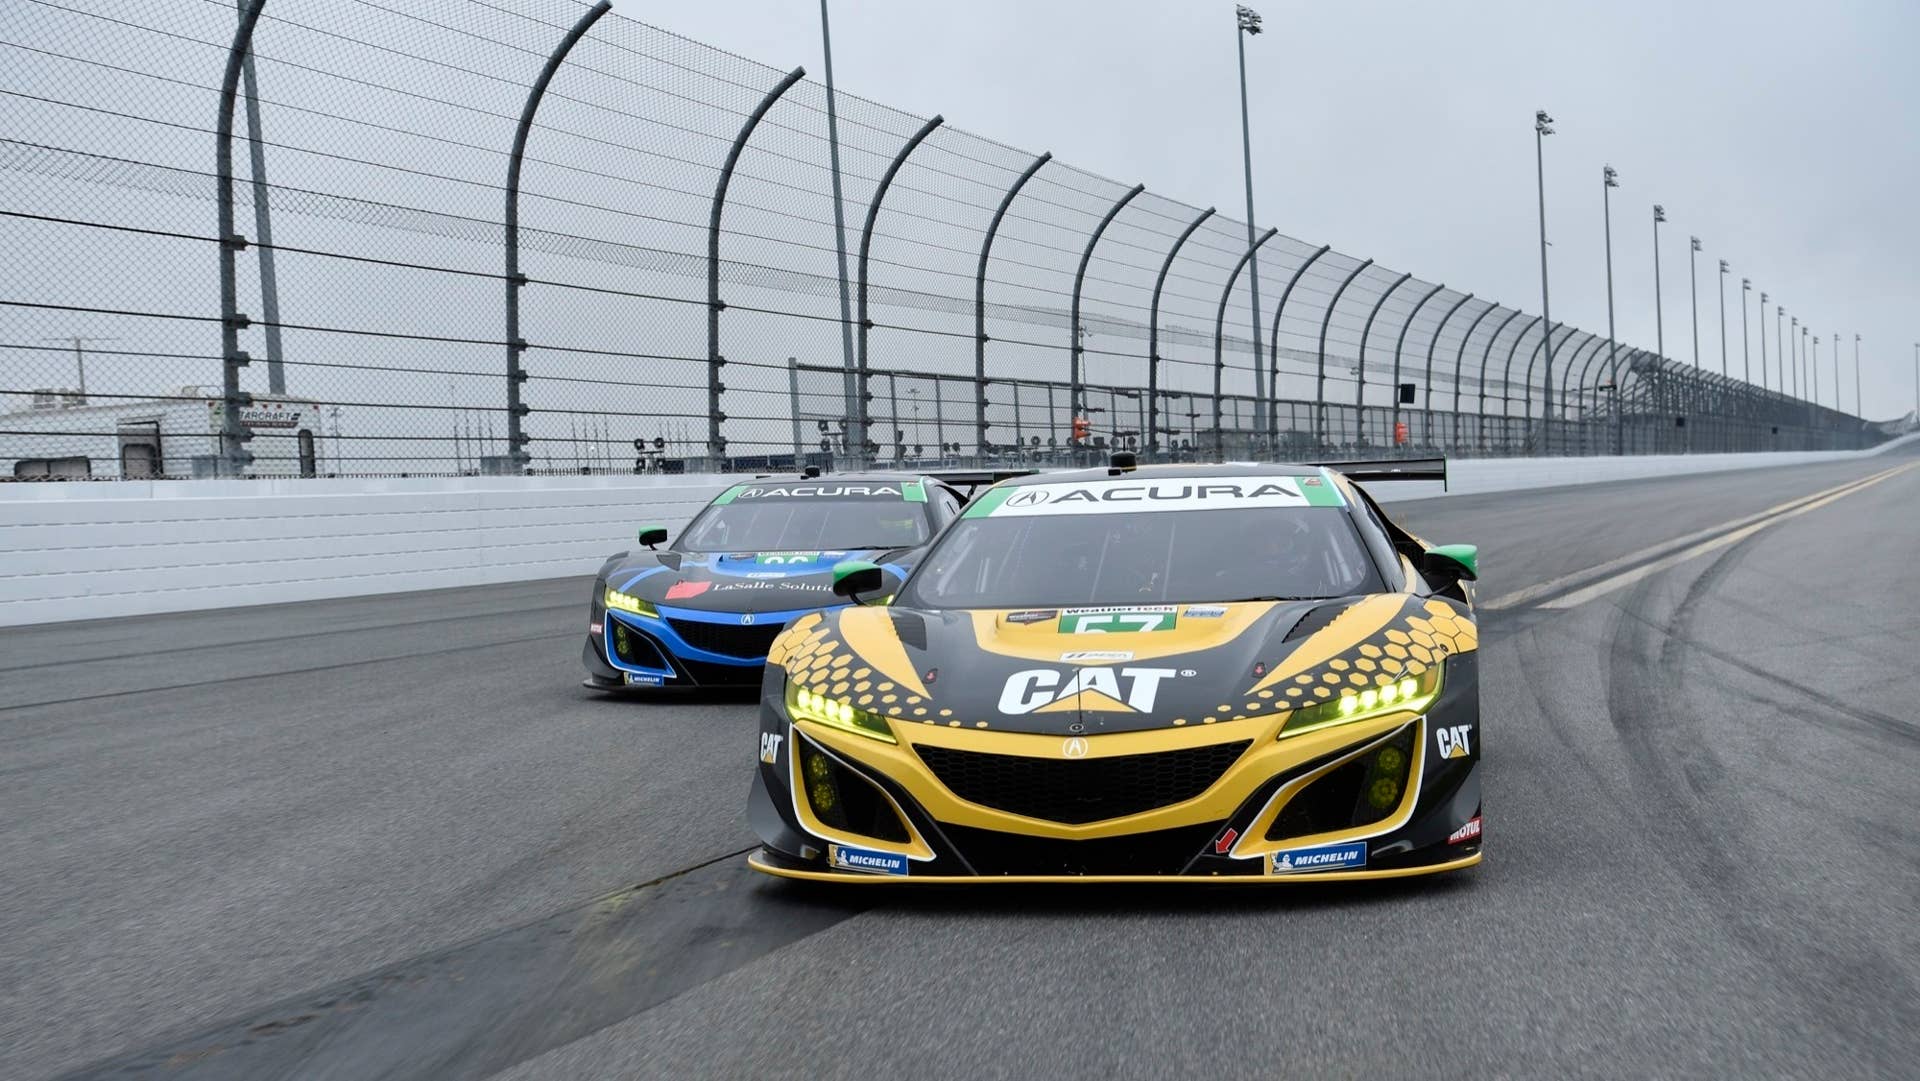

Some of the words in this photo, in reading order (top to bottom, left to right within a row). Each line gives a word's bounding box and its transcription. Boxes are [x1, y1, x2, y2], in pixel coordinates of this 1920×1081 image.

[239, 411, 291, 420] TARCRAFT
[761, 487, 901, 497] ACURA
[1049, 484, 1300, 503] ACURA
[713, 582, 775, 592] LaSalle
[849, 855, 900, 869] MICHELIN
[1294, 851, 1359, 866] MICHELIN
